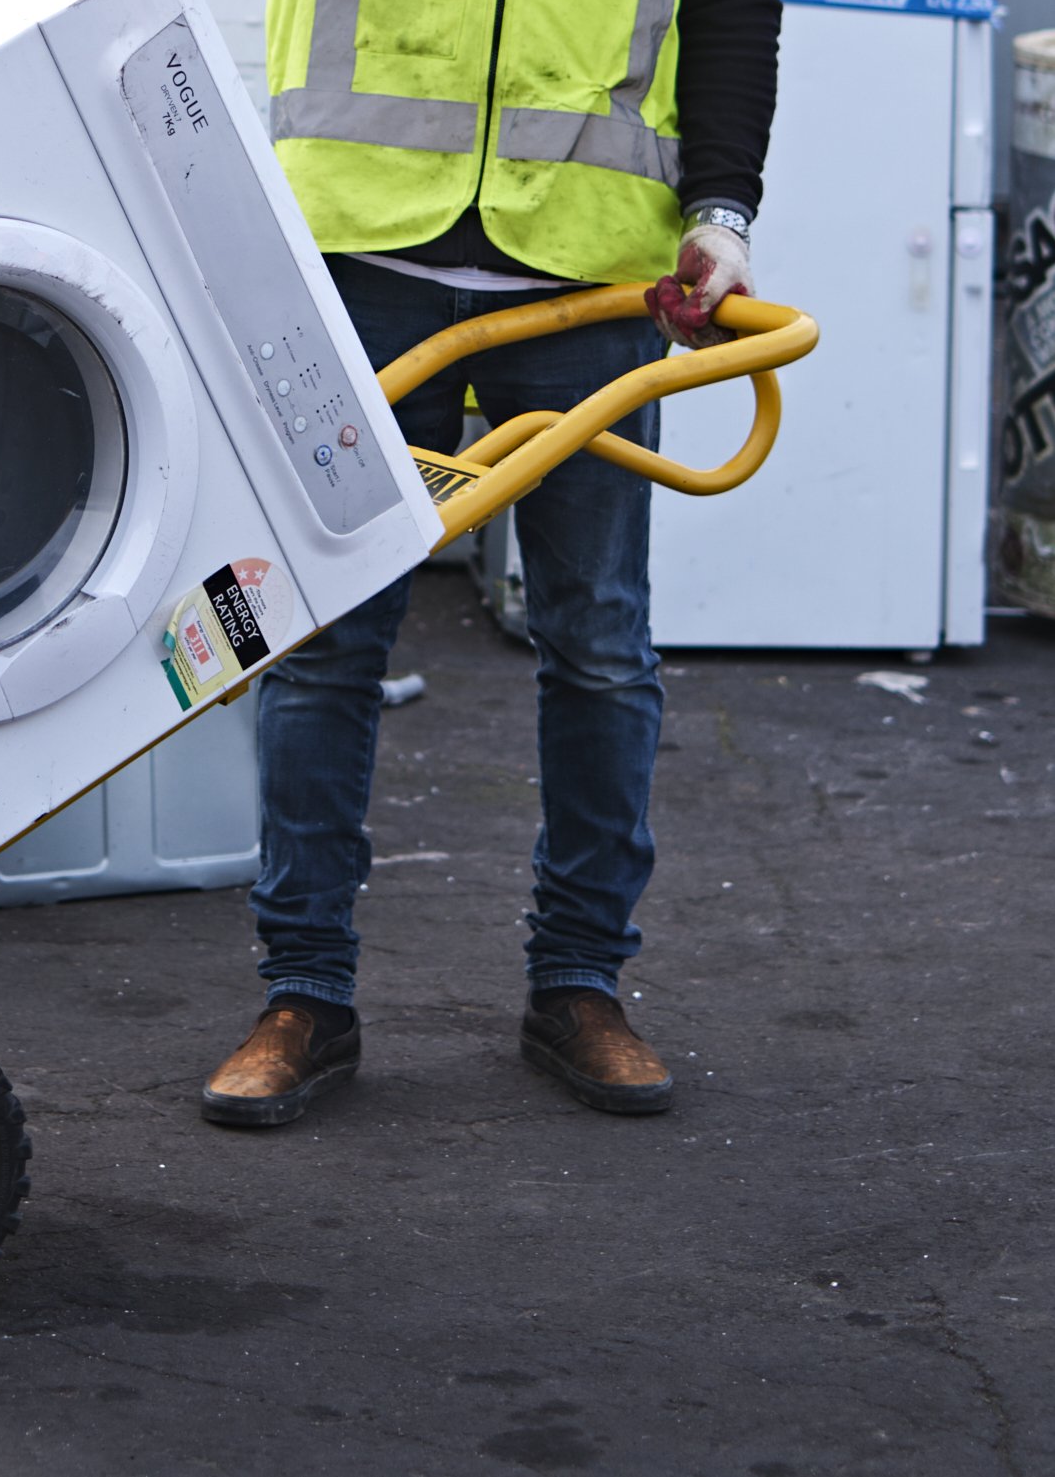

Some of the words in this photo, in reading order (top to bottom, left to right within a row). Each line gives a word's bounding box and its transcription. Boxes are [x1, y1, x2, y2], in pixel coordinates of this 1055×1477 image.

[166, 53, 209, 134] VOGUE
[162, 112, 176, 137] 7Kg
[213, 594, 244, 647] RATING
[226, 585, 259, 639] ENERGY
[190, 636, 204, 652] 311
